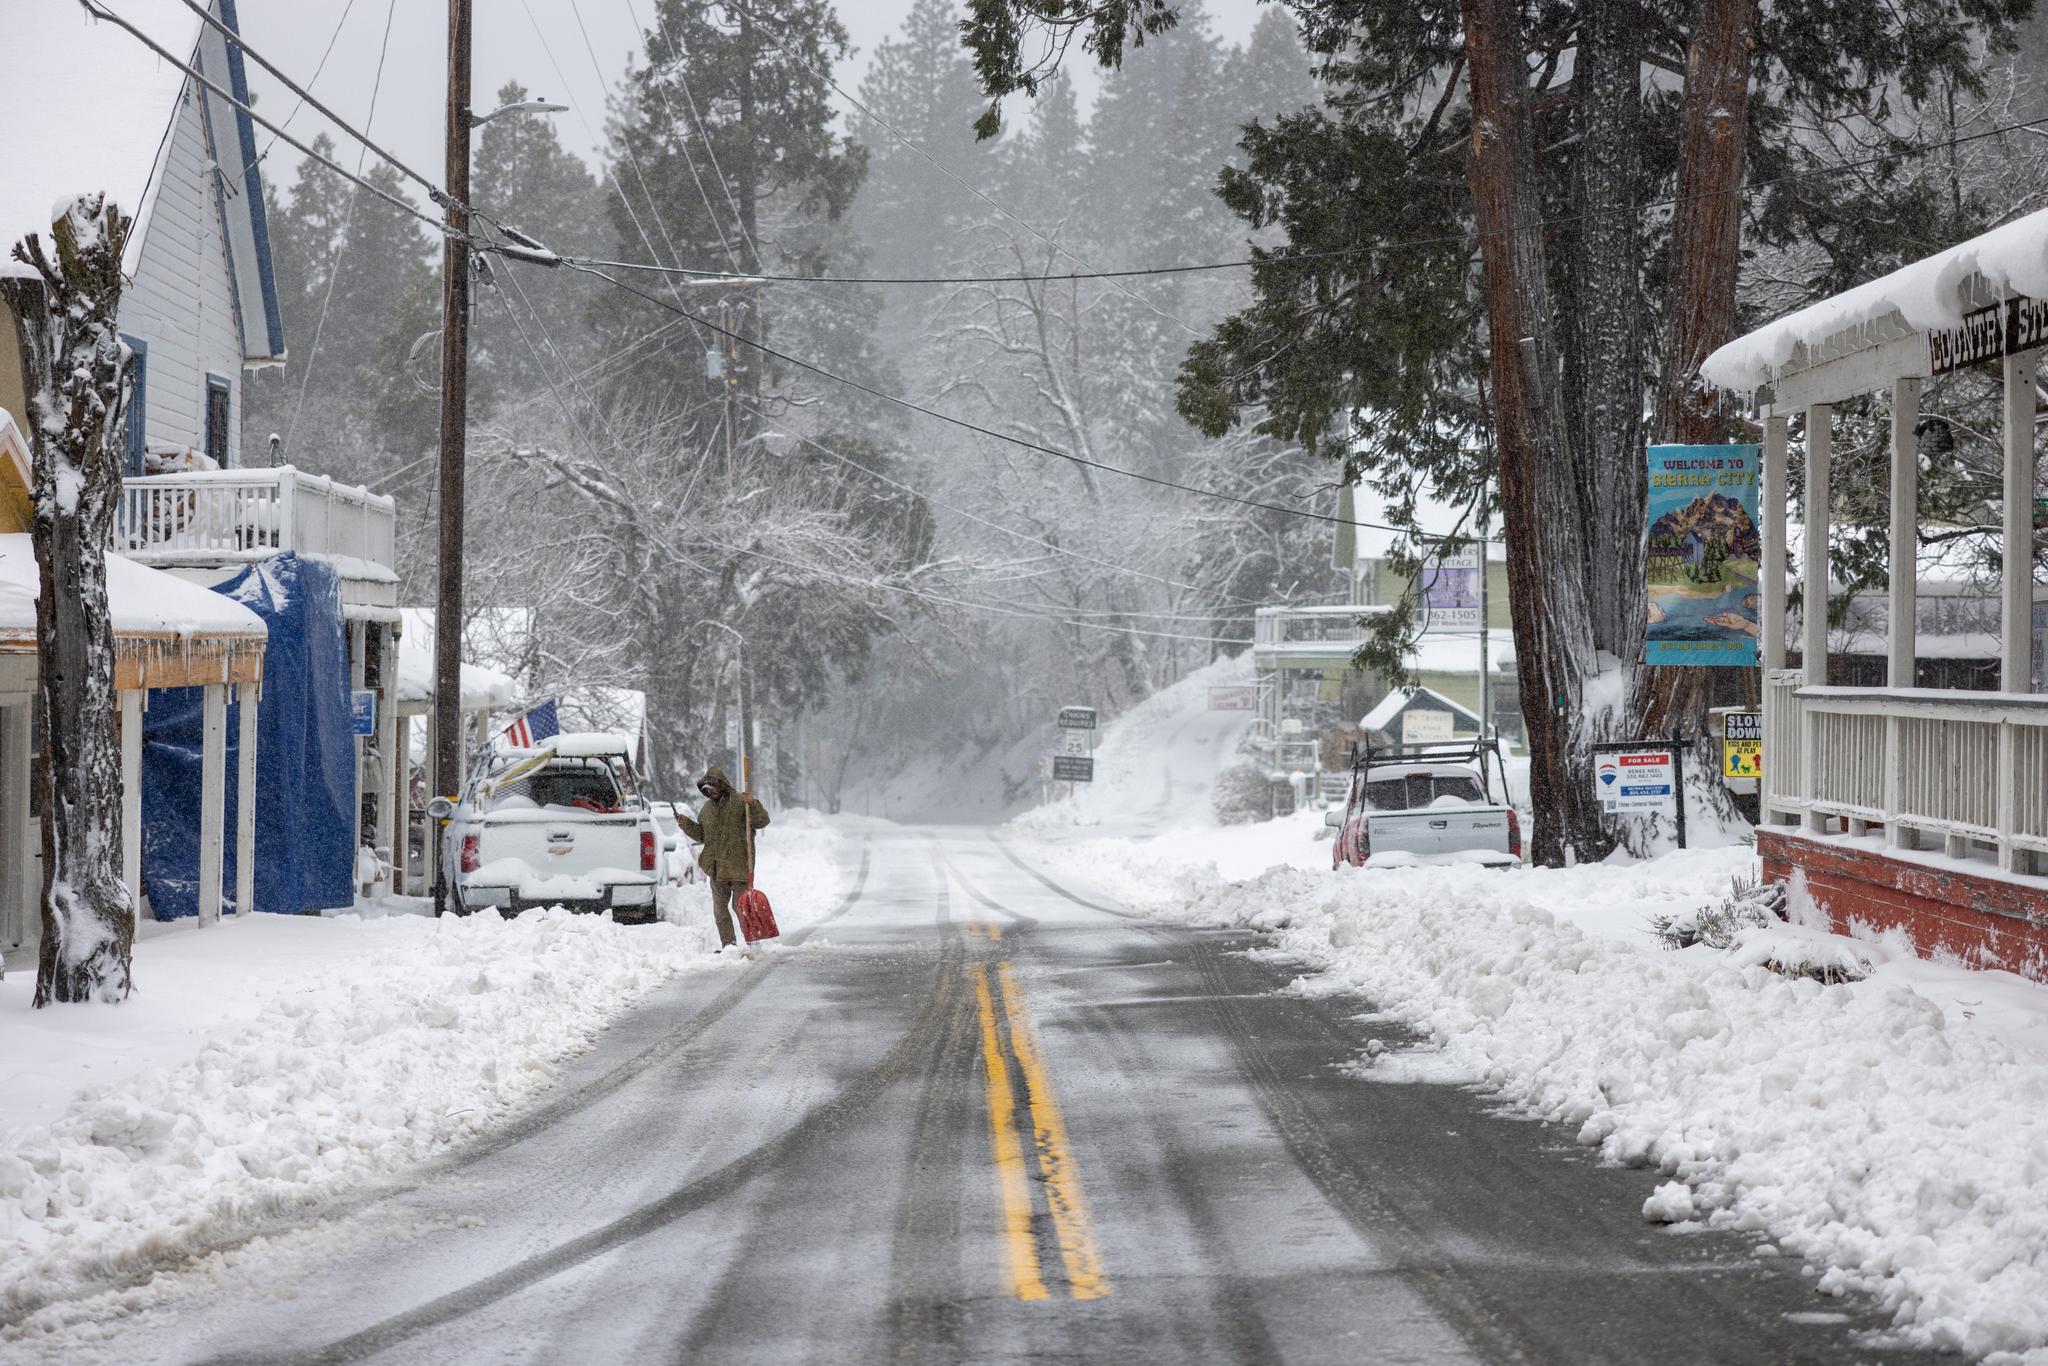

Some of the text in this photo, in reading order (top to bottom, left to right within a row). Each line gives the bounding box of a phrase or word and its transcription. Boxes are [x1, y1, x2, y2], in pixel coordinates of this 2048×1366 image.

[1663, 458, 1744, 470] WELCOME TO
[1652, 471, 1755, 487] SIERRA CITY
[1067, 743, 1082, 753] 25
